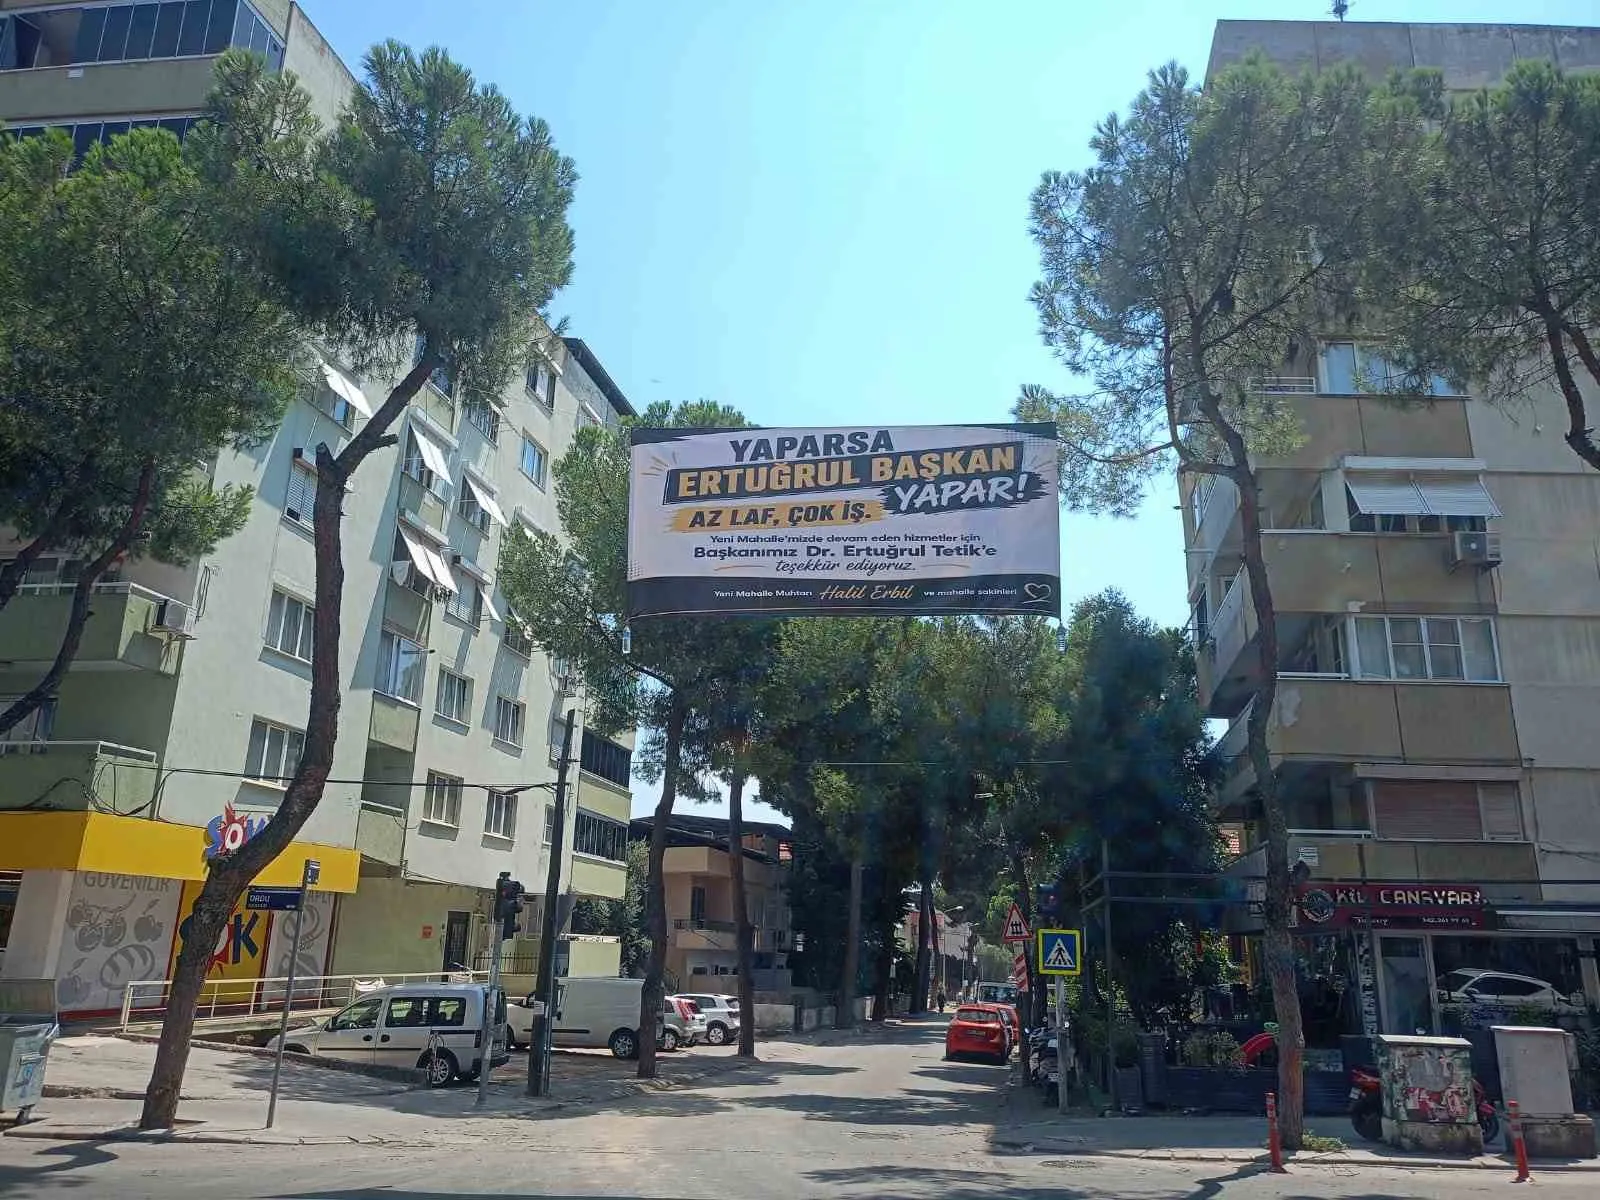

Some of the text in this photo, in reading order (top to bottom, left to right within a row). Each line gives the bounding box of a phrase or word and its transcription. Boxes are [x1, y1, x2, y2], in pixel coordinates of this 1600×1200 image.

[729, 430, 894, 462] YAPARSA
[678, 447, 1016, 497] ERTUĞRUL BAŞKAN
[894, 473, 1029, 511] YAPAR!
[689, 501, 872, 528] AZ LAF, ÇOK İŞ.
[710, 533, 981, 543] Yeni Mahalle'mizde devam eden hizmetler için
[694, 544, 998, 560] Başkanımız Dr. Ertuğrul Tetik'e
[775, 558, 917, 576] teşekkür ediyoruz.
[735, 589, 774, 597] Mahalle
[775, 589, 813, 597] Muhtarı
[819, 585, 867, 600] Halil
[870, 584, 915, 600] Erbil
[937, 588, 975, 596] mahalle
[978, 588, 1017, 596] sakinleri
